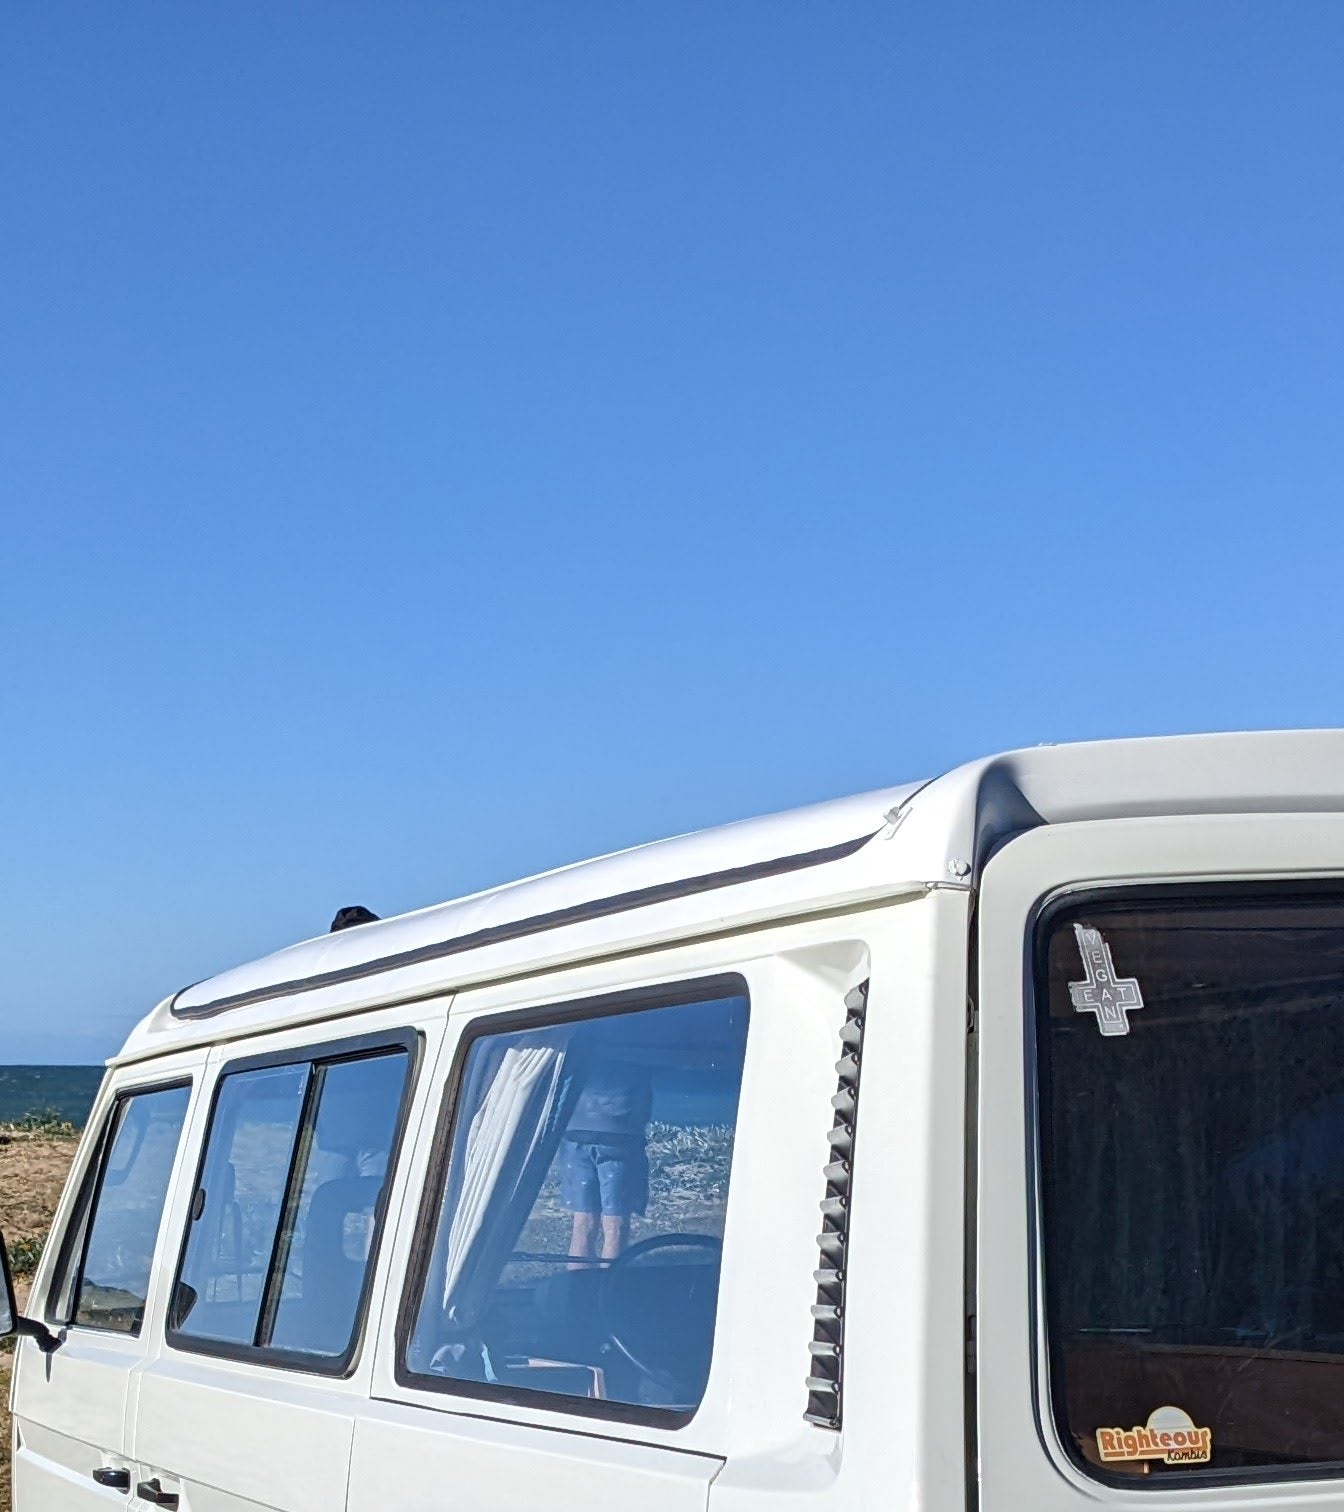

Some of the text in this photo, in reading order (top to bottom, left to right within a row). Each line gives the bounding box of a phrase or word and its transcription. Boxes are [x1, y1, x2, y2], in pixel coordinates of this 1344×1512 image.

[1086, 931, 1118, 1019] VEGAN
[1084, 988, 1126, 1002] EAT
[1099, 1428, 1210, 1456] Righteous
